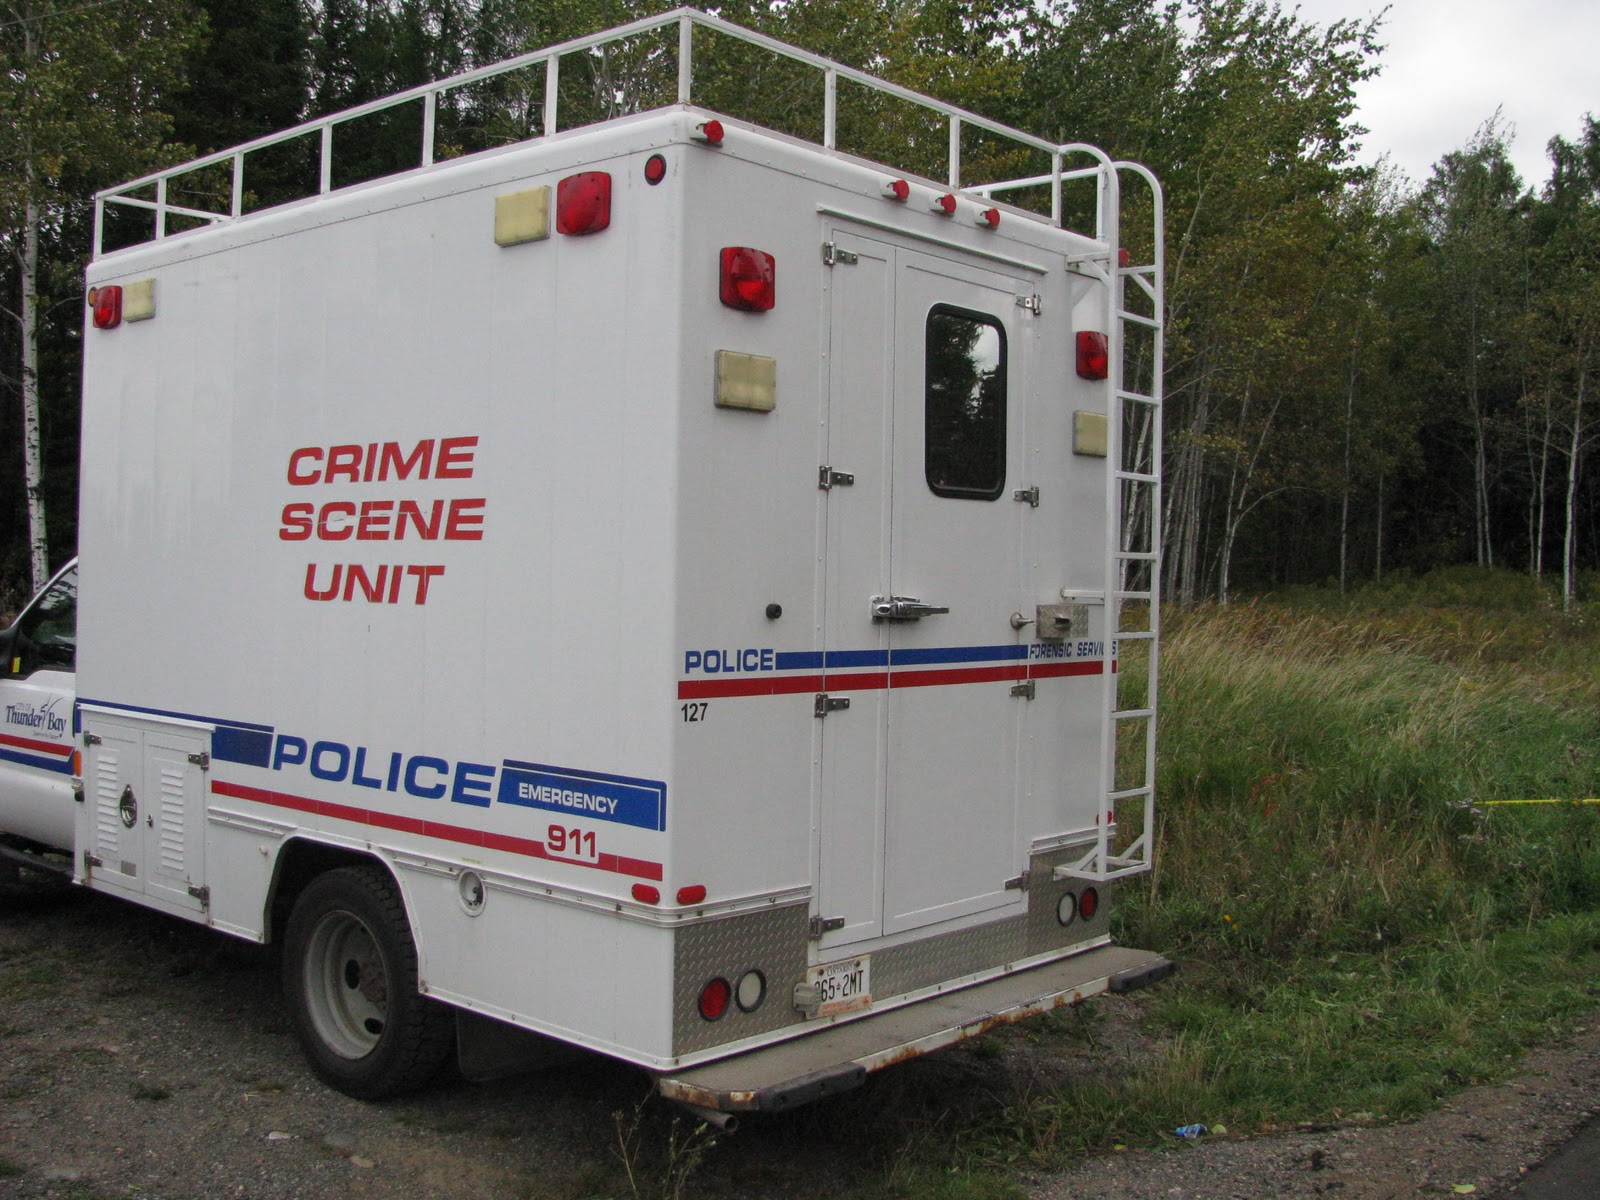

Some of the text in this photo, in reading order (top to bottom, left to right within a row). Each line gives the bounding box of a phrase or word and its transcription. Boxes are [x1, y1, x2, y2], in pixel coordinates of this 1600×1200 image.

[287, 436, 479, 486] CRIME
[279, 498, 487, 541] SCENE
[304, 563, 446, 605] UNIT
[685, 648, 774, 674] POLICE
[1029, 642, 1073, 659] FORENSIC
[6, 704, 68, 734] Thunder Bay
[681, 702, 708, 722] 127
[273, 734, 497, 808] POLICE
[518, 782, 618, 815] EMERGENCY
[547, 824, 597, 858] 911
